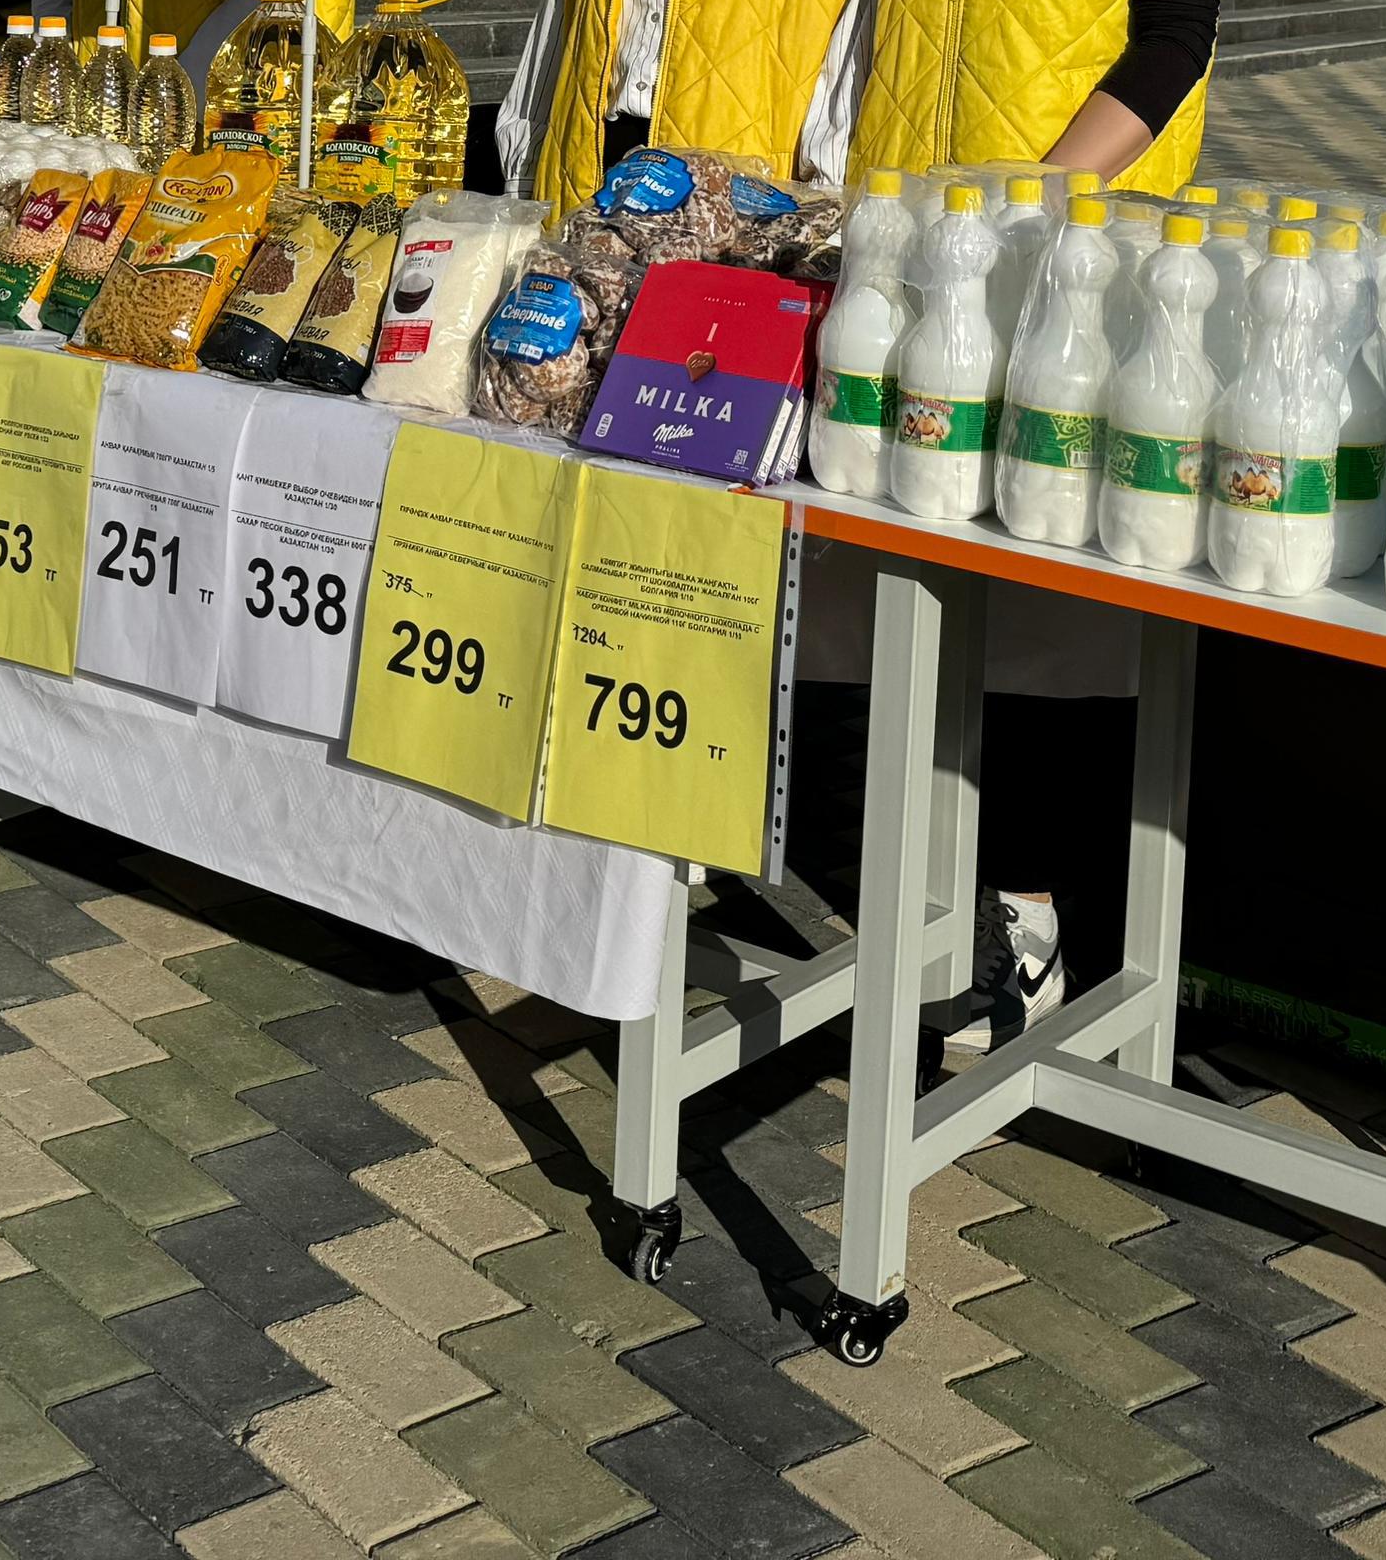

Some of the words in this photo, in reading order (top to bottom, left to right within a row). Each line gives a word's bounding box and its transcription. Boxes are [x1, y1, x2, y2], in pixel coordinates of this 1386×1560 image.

[212, 132, 264, 144] БОГАТОВСКОЕ
[325, 142, 380, 156] БОГАТОВСКОЕ
[23, 202, 54, 220] ЦАРЬ
[82, 211, 111, 228] ЦАРЬ
[501, 304, 567, 330] Северные
[634, 384, 733, 423] MILKA
[652, 423, 695, 442] Milka
[293, 484, 318, 495] ВЫБОР
[320, 490, 357, 504] ОЧЕВИДЕН
[236, 516, 258, 527] САХАР
[260, 521, 282, 533] ПЕСОК
[284, 526, 310, 538] ВЫБОР
[311, 532, 350, 547] ОЧЕВИДЕН
[454, 519, 491, 534] СЕВЕРНЫЕ
[96, 520, 181, 595] 251
[425, 546, 448, 559] АНВАР
[449, 553, 486, 569] СЕВЕРНЫЕ
[386, 573, 413, 593] 375
[640, 585, 678, 599] БОЛГАРИЯ
[245, 557, 347, 635] 338
[591, 603, 629, 617] ОРЕХОВОЙ
[688, 623, 727, 637] БОЛГАРИЯ
[599, 594, 627, 606] КОНФЕТ
[663, 607, 710, 623] МОЛОЧНОГО
[711, 617, 753, 633] ШОКОЛАДА
[572, 625, 607, 647] 1204
[386, 620, 485, 695] 299
[583, 672, 688, 749] 799
